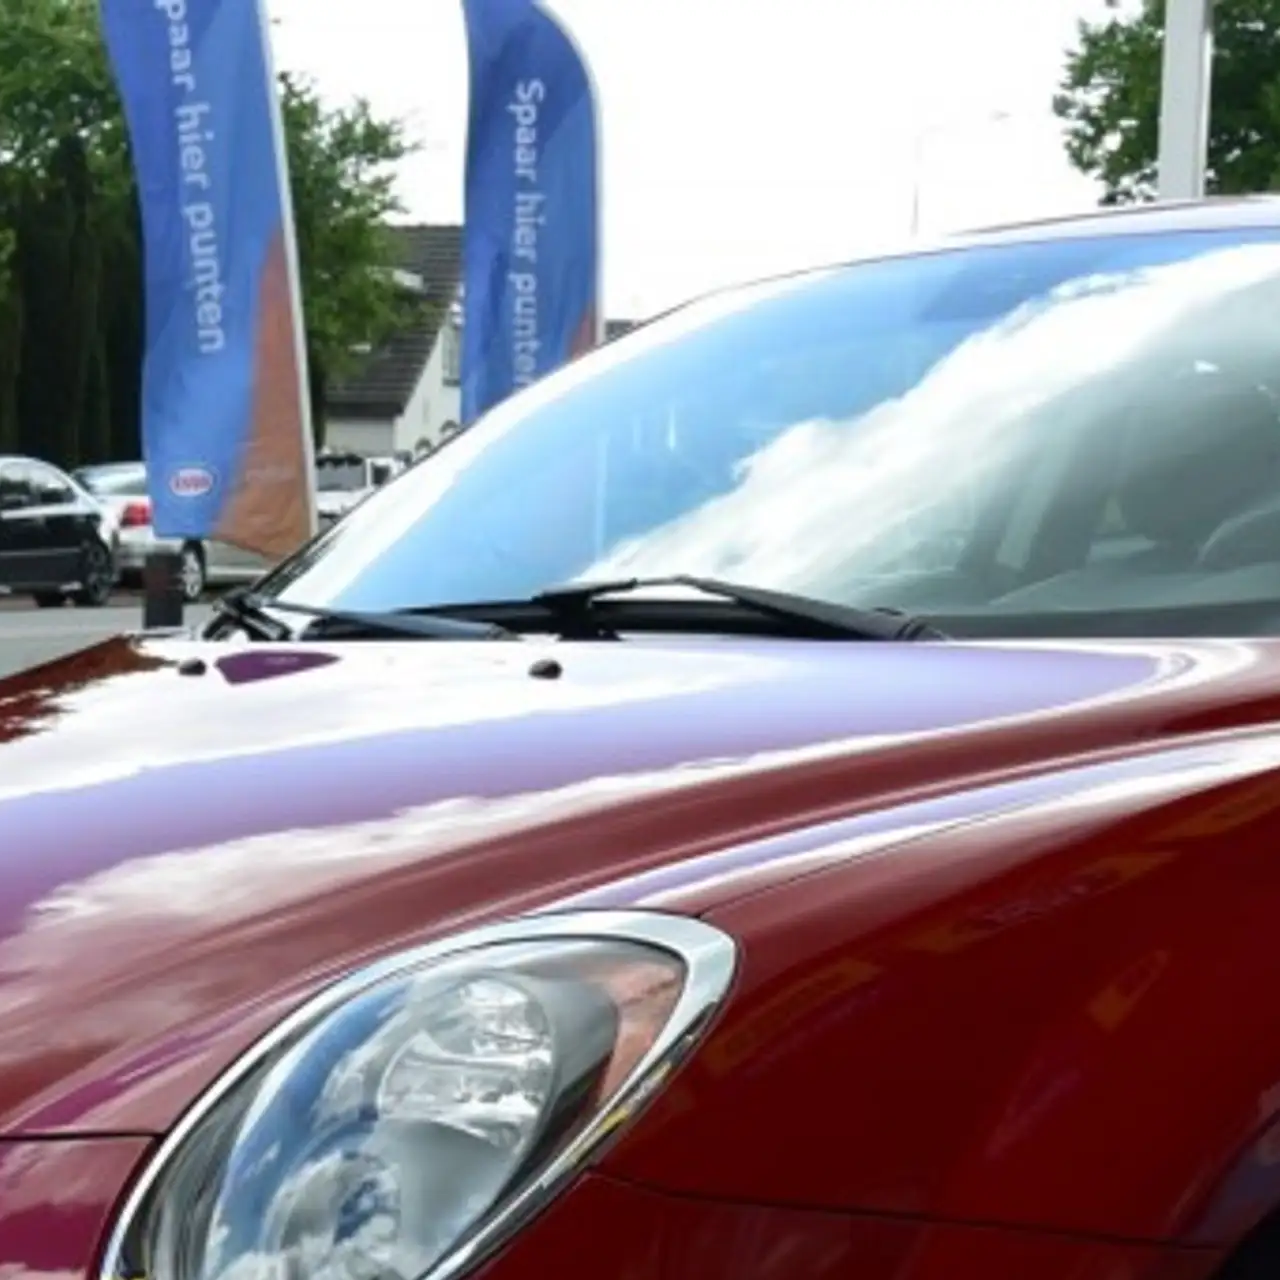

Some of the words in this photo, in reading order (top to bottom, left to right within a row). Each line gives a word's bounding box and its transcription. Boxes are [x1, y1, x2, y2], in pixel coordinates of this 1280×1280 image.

[175, 102, 215, 191] hier
[505, 77, 546, 182] Spaar
[514, 192, 547, 264] hier
[183, 202, 226, 354] punten
